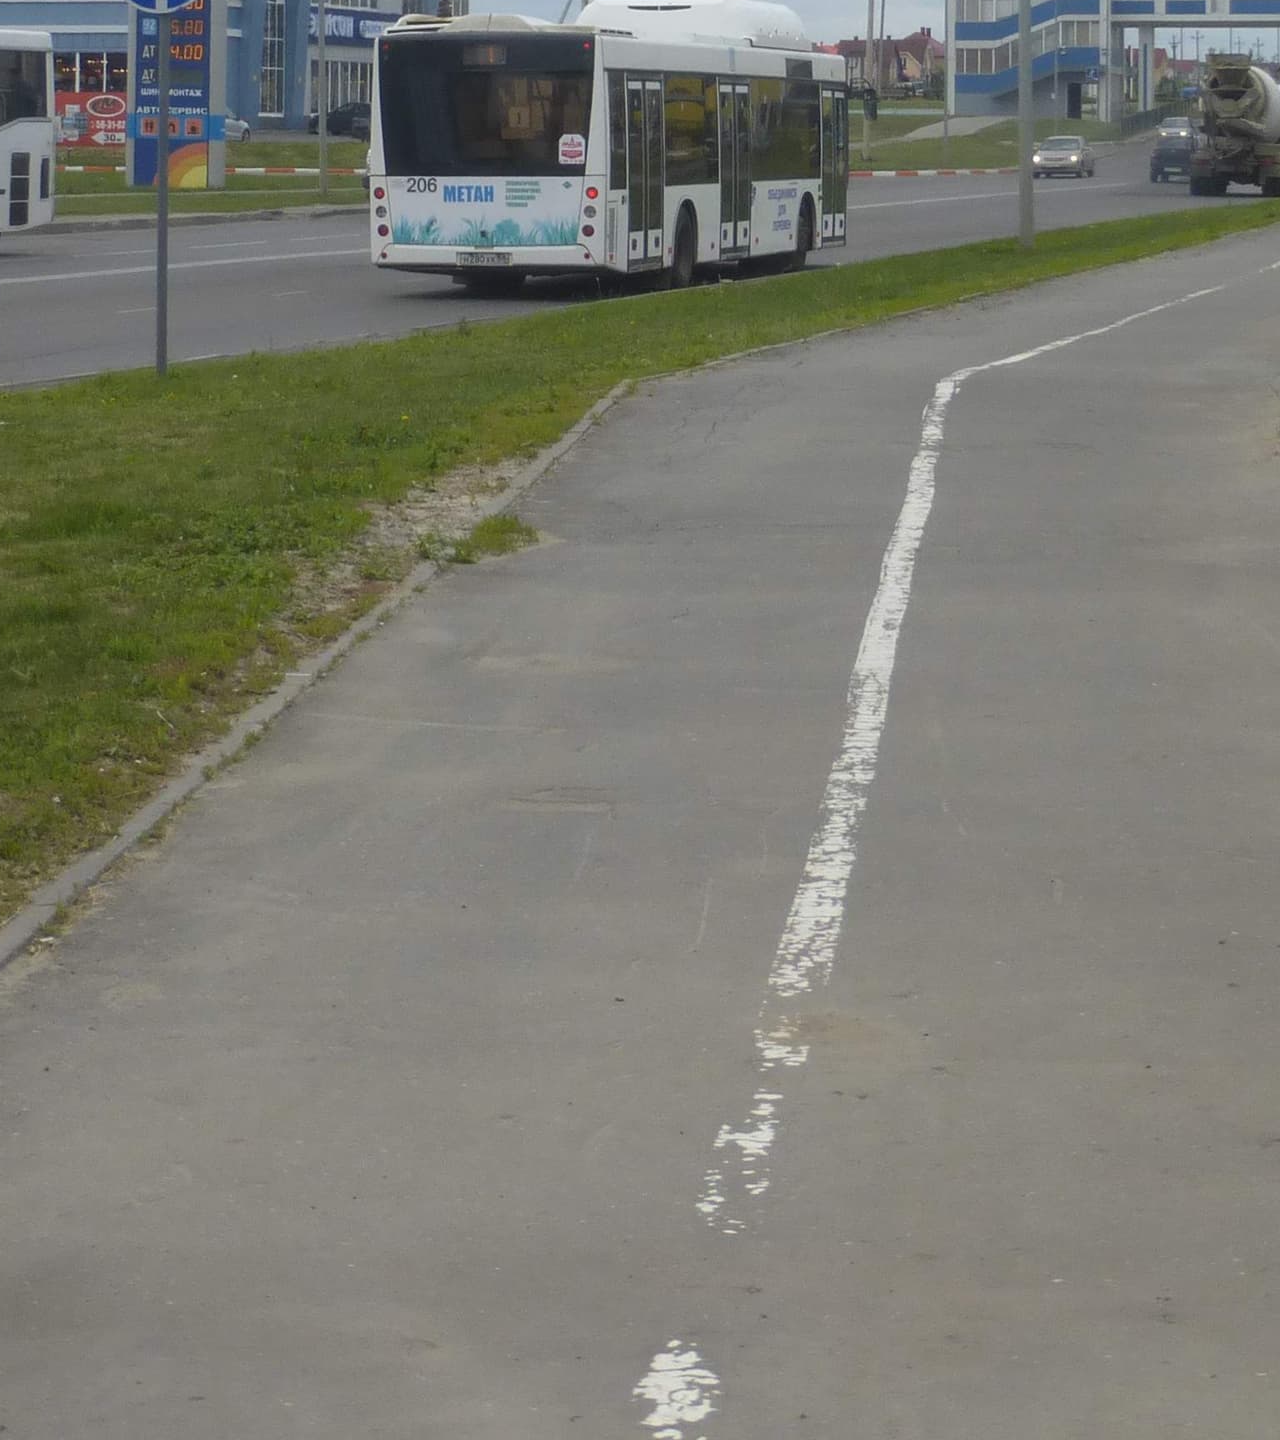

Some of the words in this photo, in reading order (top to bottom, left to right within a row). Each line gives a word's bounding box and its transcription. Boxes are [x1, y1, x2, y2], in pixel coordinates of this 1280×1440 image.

[170, 19, 204, 36] 5.80
[169, 44, 203, 60] 4.00
[140, 88, 202, 96] ШИНОНТАЖ
[406, 177, 438, 193] 206
[443, 185, 494, 203] МЕТАН
